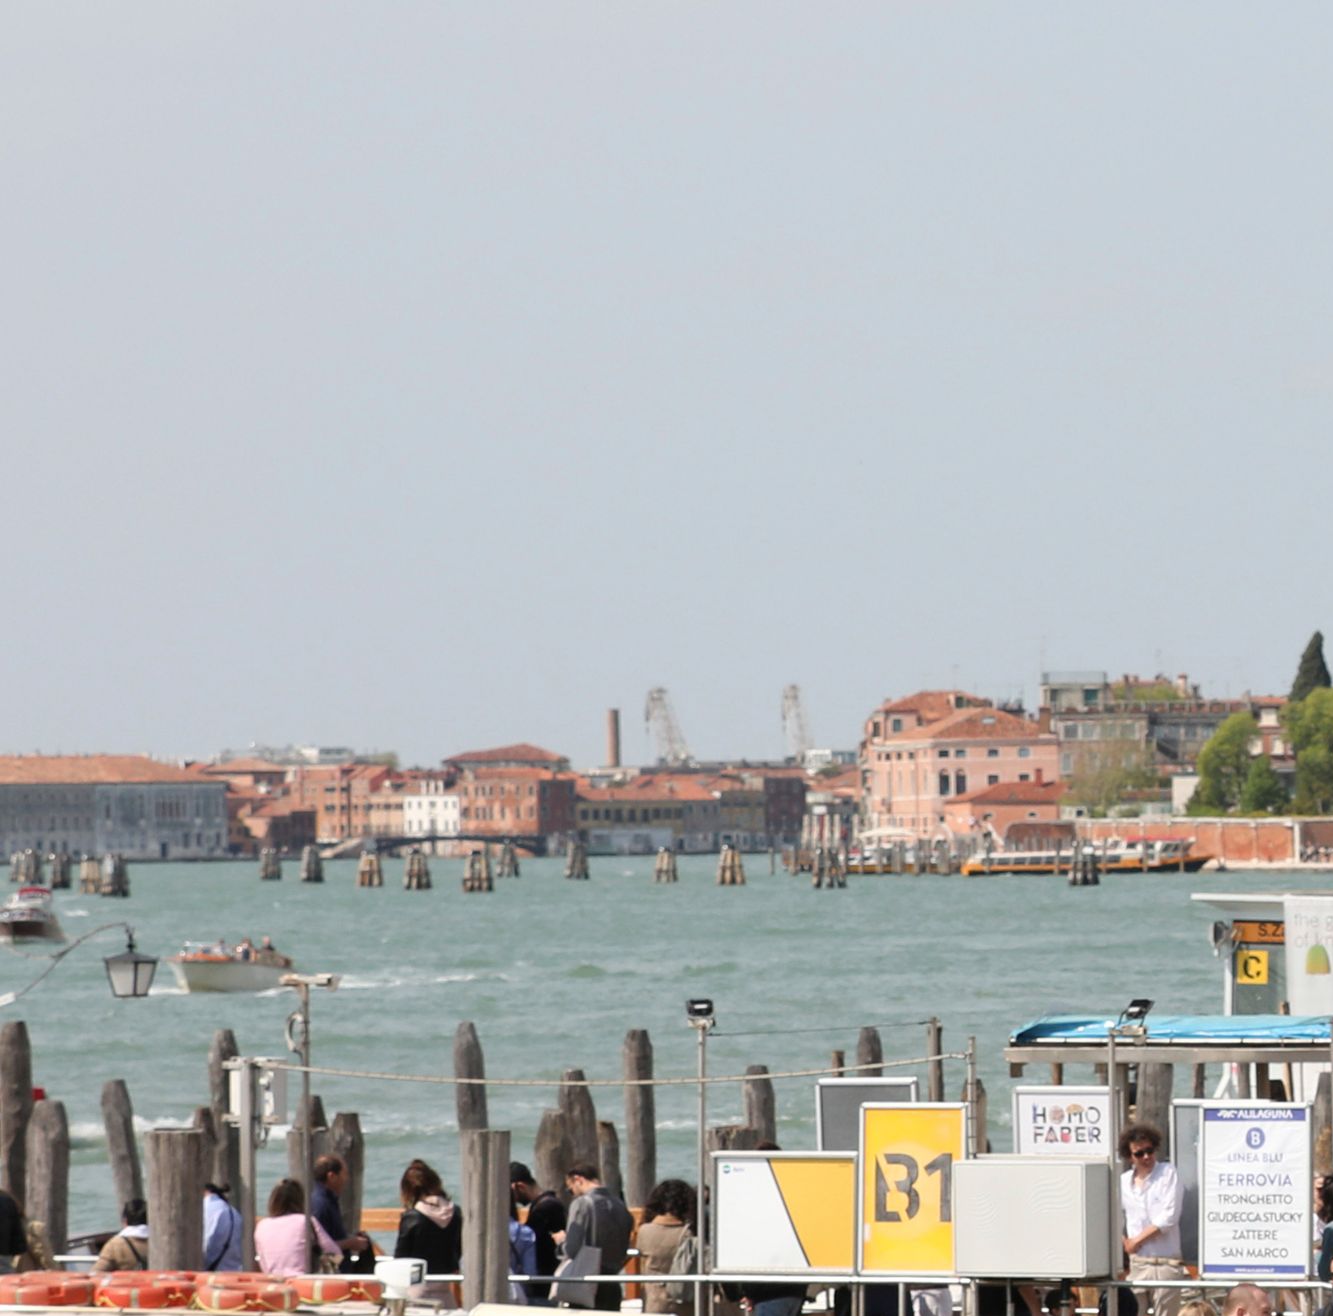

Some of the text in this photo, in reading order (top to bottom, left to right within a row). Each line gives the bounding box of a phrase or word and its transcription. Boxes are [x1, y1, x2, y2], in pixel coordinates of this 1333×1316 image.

[1295, 932, 1310, 946] of
[1243, 955, 1261, 979] C
[1032, 1103, 1101, 1124] HOMO
[1237, 1109, 1293, 1119] ALILAGUNA
[1033, 1126, 1101, 1144] FABER
[1251, 1131, 1261, 1146] B
[1228, 1153, 1284, 1163] LINEA BLU
[1218, 1173, 1293, 1187] FERROVIA
[874, 1153, 953, 1223] B1
[1217, 1194, 1293, 1205] TRONCHETTO
[1207, 1212, 1303, 1223] GIUDECCA STUCKY
[1232, 1230, 1278, 1241] ZATTERE
[1220, 1247, 1289, 1258] SAN MARCO
